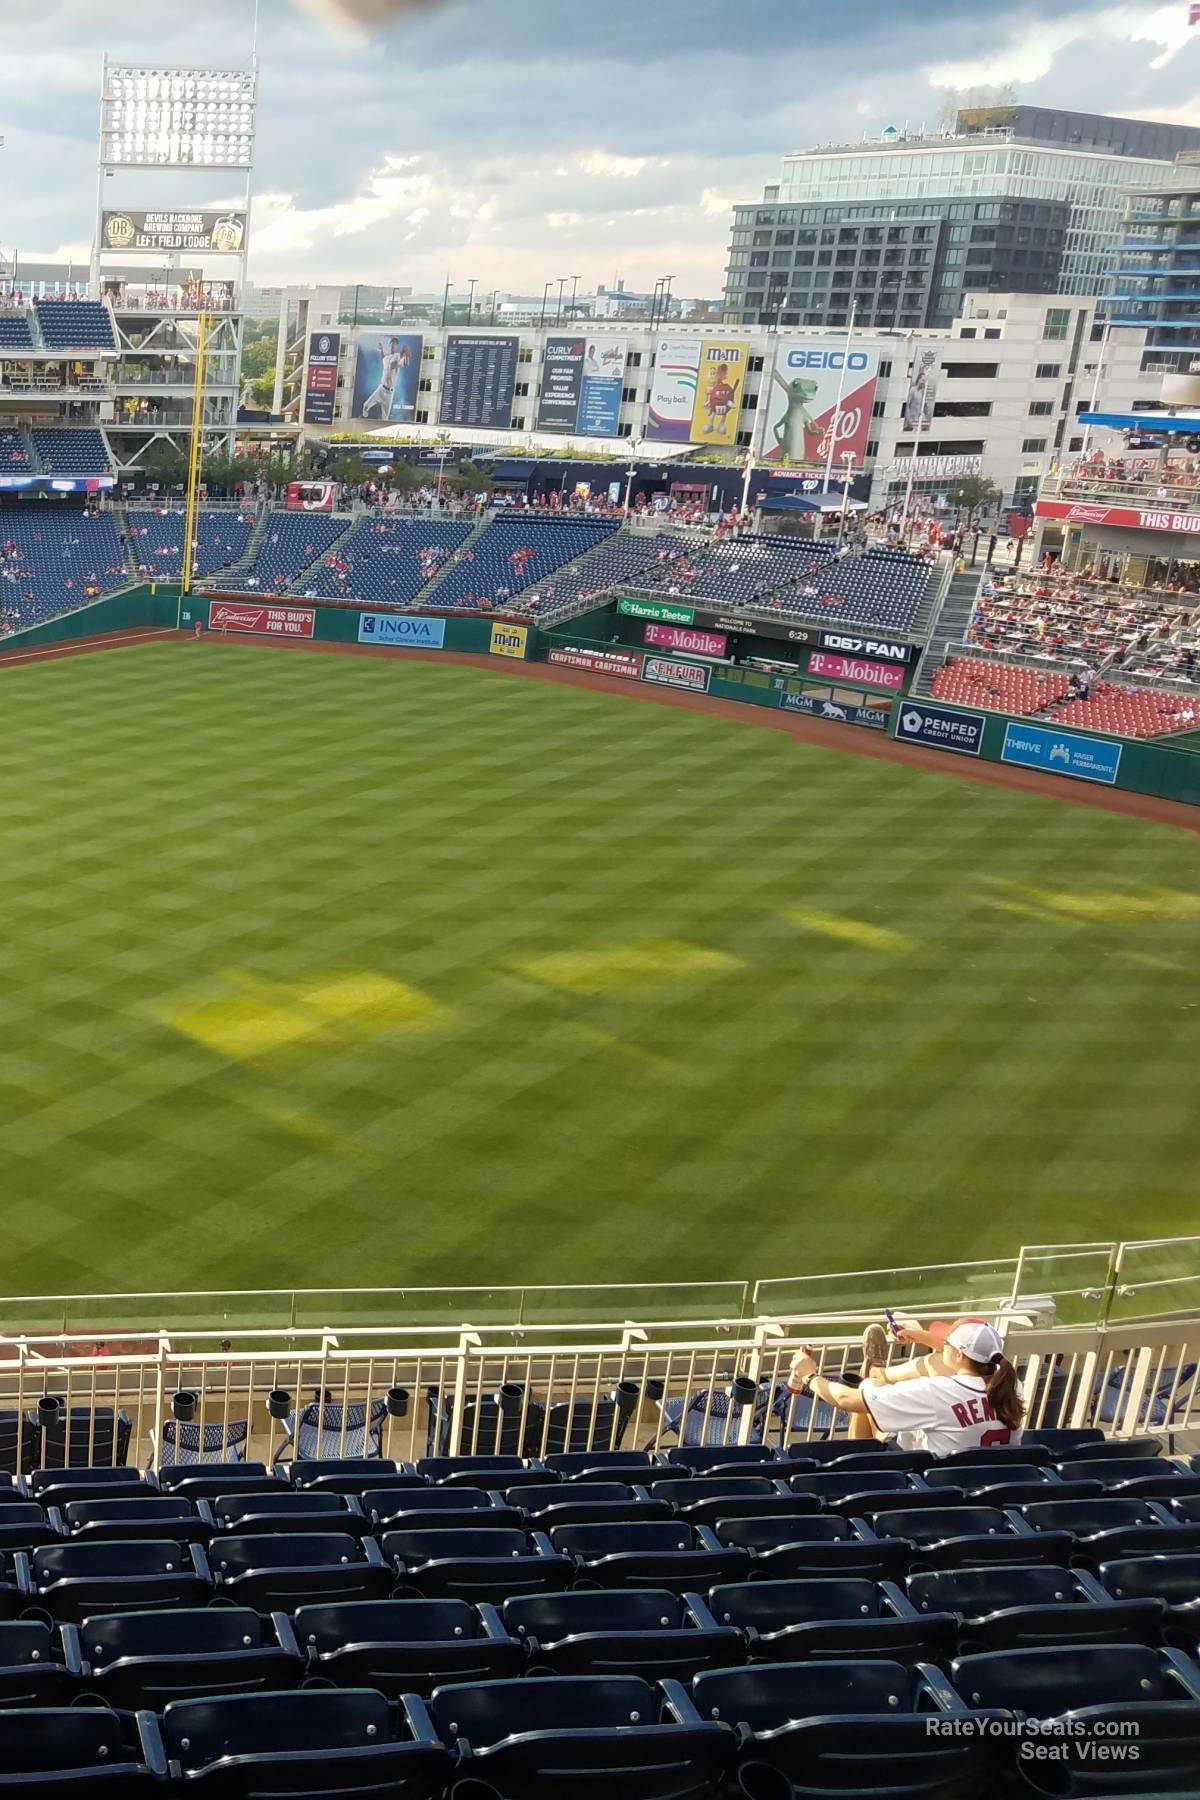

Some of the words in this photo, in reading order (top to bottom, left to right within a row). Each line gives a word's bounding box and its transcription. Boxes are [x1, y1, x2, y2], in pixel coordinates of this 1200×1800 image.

[136, 235, 156, 247] LEFT
[158, 235, 182, 247] FIELD
[183, 235, 211, 248] LODGE
[547, 345, 573, 355] CURLY
[787, 350, 868, 371] GEICO
[657, 394, 672, 404] Play
[1138, 511, 1170, 529] THIS
[267, 610, 286, 620] THIS
[287, 612, 312, 623] BUD'S
[630, 603, 660, 618] Harris
[661, 608, 691, 622] Teeter
[266, 621, 283, 631] FOR
[284, 622, 303, 632] YOU.
[380, 620, 432, 636] INOVA
[719, 617, 744, 626] WELCOME
[788, 630, 809, 641] 6:29
[865, 641, 906, 659] FAN
[550, 652, 592, 667] CRAFTSMAN
[594, 661, 638, 676] CRAFTSMAN
[785, 694, 813, 708] MGM
[855, 708, 885, 723] MGM
[924, 717, 978, 737] PENFED
[922, 728, 949, 739] CREDIT
[950, 733, 976, 744] UNION
[1006, 738, 1042, 754] THRIVE
[1073, 751, 1095, 762] KAISER
[951, 1396, 998, 1429] REN
